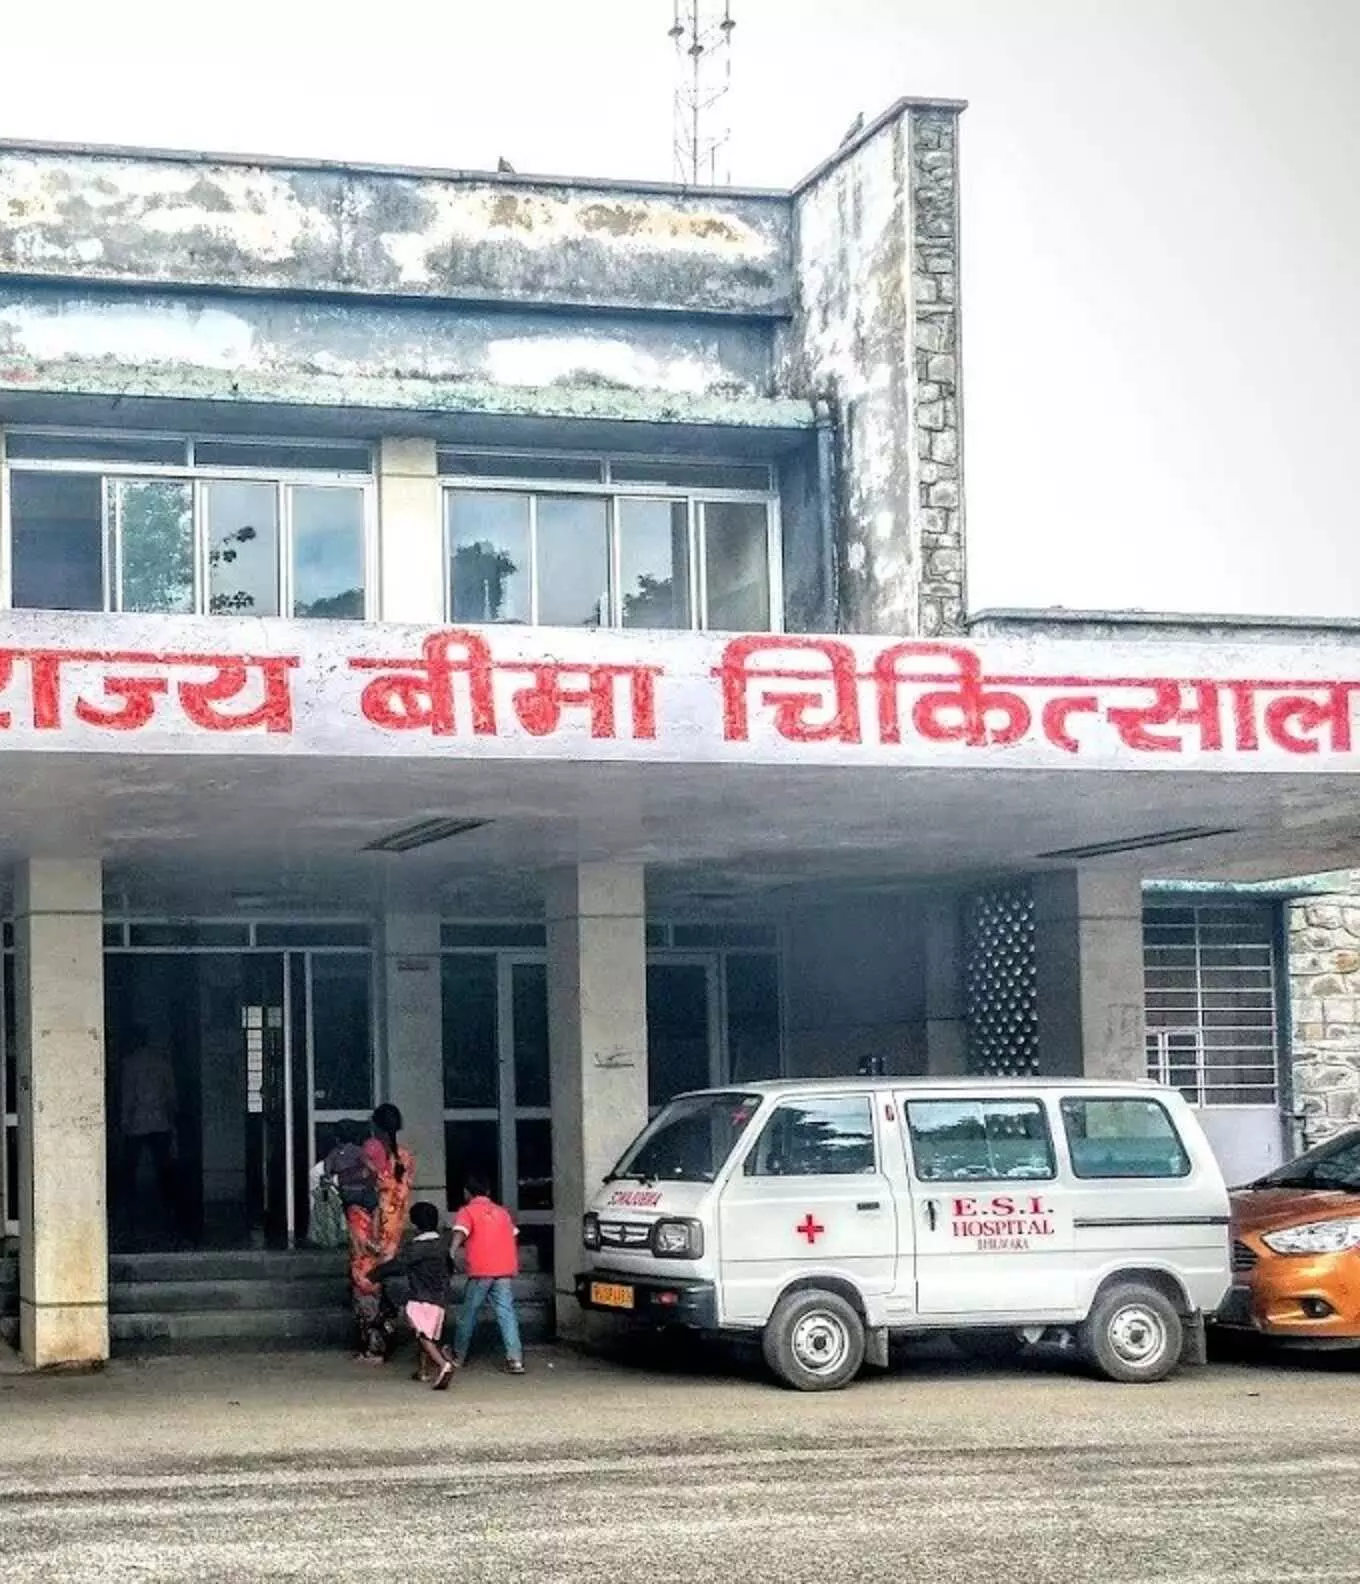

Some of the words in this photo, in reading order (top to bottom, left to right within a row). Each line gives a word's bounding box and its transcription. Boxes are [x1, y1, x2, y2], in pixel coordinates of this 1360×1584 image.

[349, 631, 663, 740] बीमा
[952, 1196, 1055, 1217] E.S.I.
[952, 1219, 1055, 1237] HOSPITAL
